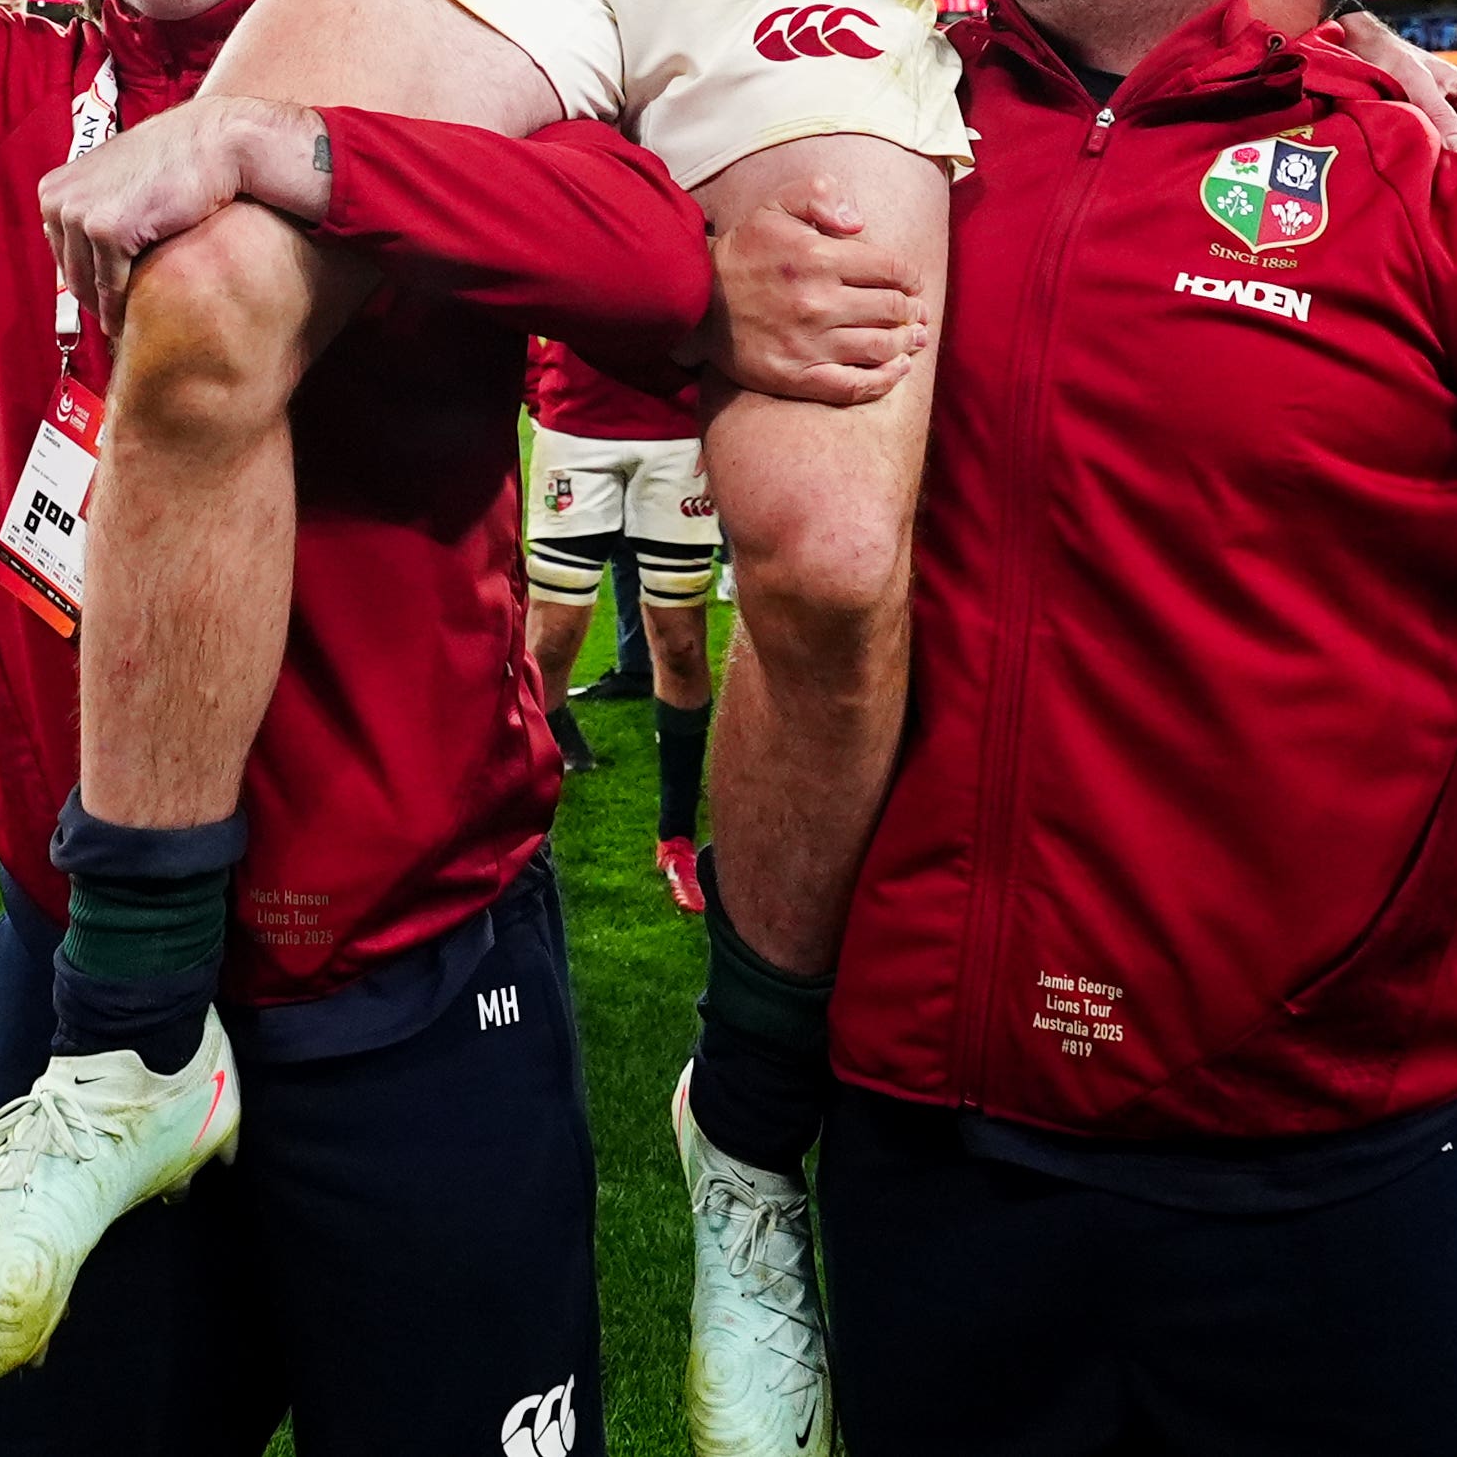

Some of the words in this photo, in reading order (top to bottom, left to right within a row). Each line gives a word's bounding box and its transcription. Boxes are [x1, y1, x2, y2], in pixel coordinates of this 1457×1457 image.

[1209, 243, 1258, 266] SINCE
[1262, 256, 1298, 270] 1888
[1174, 272, 1311, 322] HOWDEN
[284, 889, 329, 906] Hansen
[257, 909, 290, 925] Lions
[294, 910, 319, 926] Tour
[254, 930, 301, 945] stralia
[304, 929, 334, 945] 2025
[1037, 970, 1075, 991] Jamie
[1078, 976, 1124, 1000] George
[477, 985, 521, 1031] MH
[1046, 994, 1080, 1015] Lions
[1083, 999, 1112, 1018] Tour
[1033, 1012, 1089, 1037] Australia
[1093, 1023, 1124, 1041] 2025
[1061, 1038, 1093, 1057] #819
